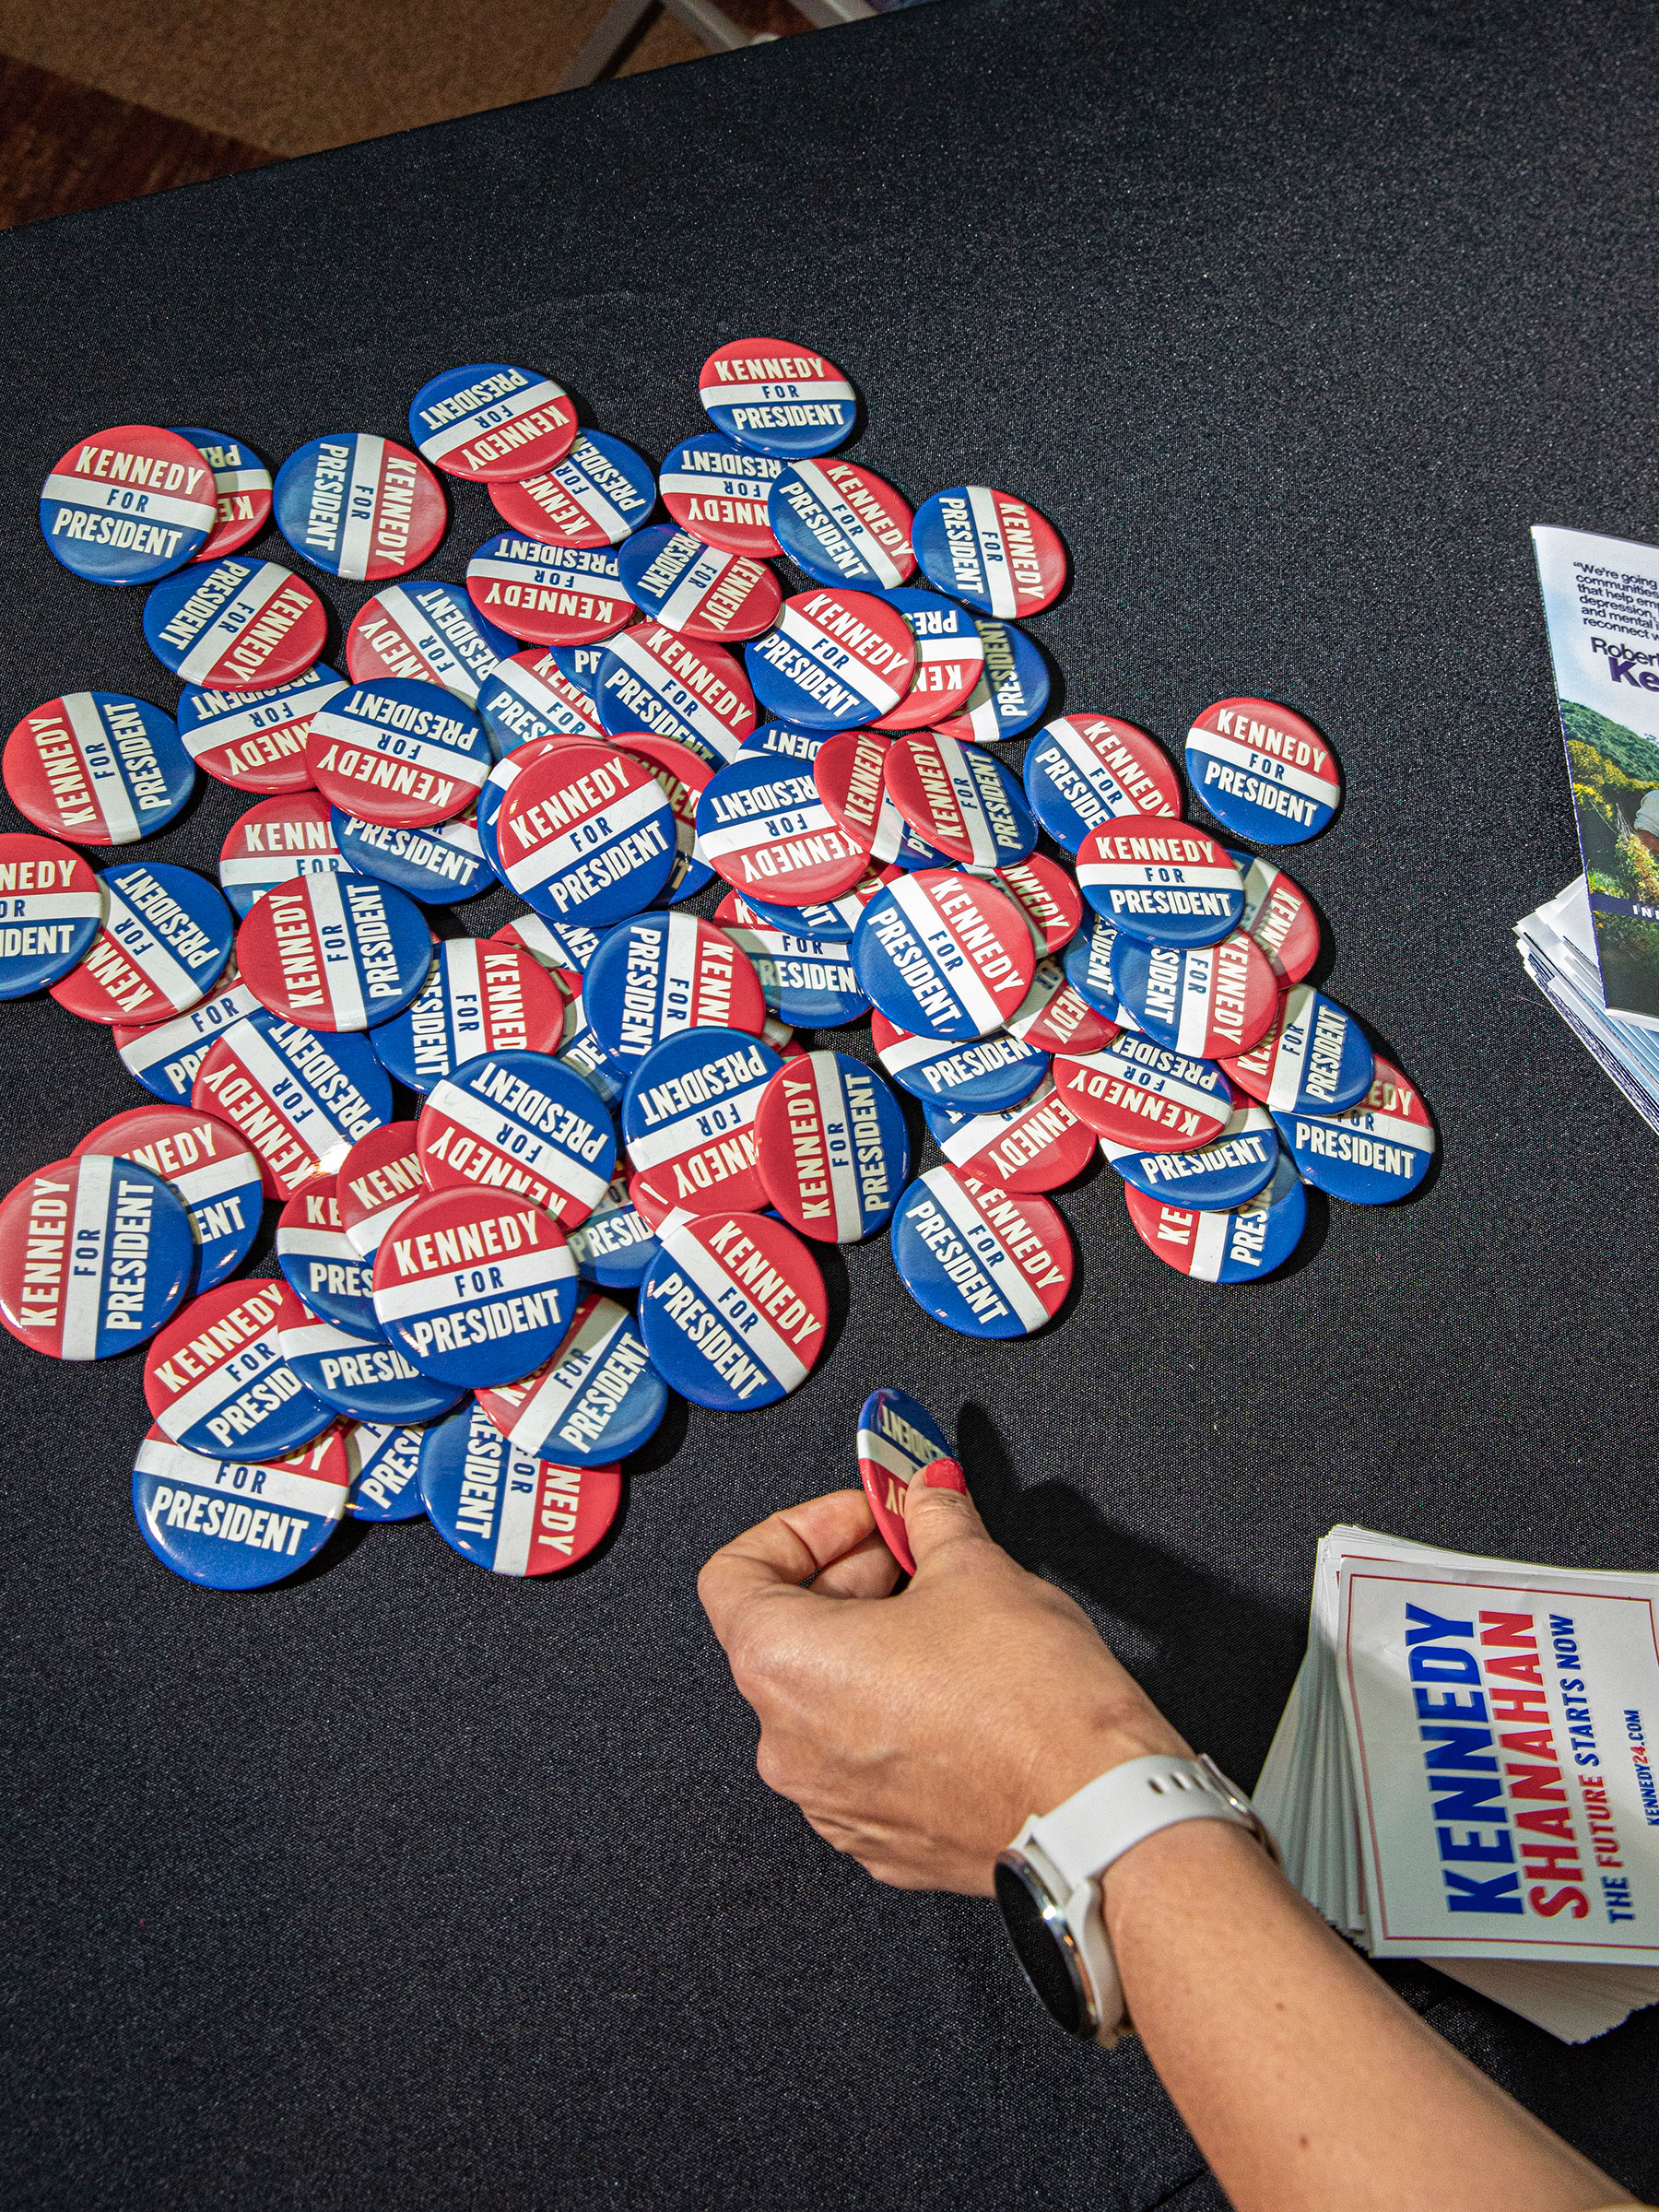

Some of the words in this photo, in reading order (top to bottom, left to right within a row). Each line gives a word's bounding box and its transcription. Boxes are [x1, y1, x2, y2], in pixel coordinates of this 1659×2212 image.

[714, 358, 826, 382] KENNEDY
[761, 384, 799, 399] FOR
[419, 369, 529, 430] PRESIDENT
[475, 405, 512, 429] FOR
[733, 404, 845, 430] PRESIDENT
[461, 406, 570, 471] KENNEDY
[681, 450, 783, 478] RESIDENT
[76, 446, 206, 494] KENNEDY
[305, 443, 349, 551] PRESIDENT
[551, 465, 589, 495] FOR
[724, 481, 761, 499] FOR
[107, 488, 148, 512] FOR
[355, 486, 373, 520] FOR
[375, 457, 417, 565] KENNEDY
[827, 465, 915, 558] KENNEDY
[832, 503, 864, 537] FOR
[53, 508, 182, 559] PRESIDENT
[495, 539, 618, 579] PRESIDENT
[779, 481, 869, 579] PRESIDENT
[938, 497, 983, 594] PRESIDENT
[982, 531, 1004, 562] FOR
[999, 502, 1044, 599] KENNEDY
[535, 571, 575, 588] FOR
[637, 533, 702, 598] RESIDENT
[688, 562, 718, 589] FOR
[700, 556, 767, 631] KENNEDY
[1577, 583, 1604, 597] that
[1606, 589, 1633, 605] help
[1621, 573, 1658, 591] going
[159, 559, 251, 650] PRESIDENT
[218, 601, 255, 633] FOR
[485, 582, 614, 624] KENNEDY
[1579, 594, 1656, 622] depression,
[1582, 606, 1606, 618] and
[1609, 611, 1653, 629] mental
[1583, 618, 1649, 640] reconnect
[223, 589, 313, 682] KENNEDY
[418, 633, 455, 673] FOR
[802, 593, 910, 676] KENNEDY
[811, 638, 849, 669] FOR
[646, 626, 753, 728] KENNEDY
[661, 679, 699, 717] FOR
[753, 634, 862, 717] PRESIDENT
[248, 701, 295, 728] FOR
[343, 690, 479, 752] PRESIDENT
[546, 704, 586, 735] FOR
[604, 668, 717, 763] PRESIDENT
[1216, 709, 1326, 774] KENNEDY
[28, 715, 97, 826] KENNEDY
[86, 742, 115, 781] FOR
[103, 702, 171, 810] PRESIDENT
[377, 733, 422, 760] FOR
[1084, 720, 1175, 818] KENNEDY
[1249, 753, 1285, 781] FOR
[317, 745, 454, 808] KENNEDY
[509, 757, 630, 849] KENNEDY
[711, 774, 820, 822] RESIDENT
[844, 735, 887, 826] KENNEDY
[908, 740, 965, 838] KENNEDY
[953, 777, 978, 809] FOR
[966, 750, 1022, 850] PRESIDENT
[1035, 747, 1111, 830] PRESIDE
[1088, 768, 1122, 805] FOR
[1204, 762, 1319, 827] PRESIDENT
[244, 821, 339, 852] KENN
[345, 817, 479, 886] PRESIDENT
[570, 817, 613, 853] FOR
[766, 813, 807, 837] FOR
[1095, 837, 1214, 864] KENNEDY
[547, 819, 668, 914] PRESIDENT
[740, 830, 863, 883] KENNEDY
[1145, 867, 1185, 883] FOR
[113, 868, 220, 969] PRESIDENT
[1111, 889, 1231, 916] PRESIDENT
[1259, 888, 1301, 955] KENN
[114, 917, 154, 956] FOR
[270, 893, 324, 1008] KENNEDY
[322, 924, 348, 962] FOR
[347, 885, 402, 999] PRESIDENT
[782, 935, 823, 955] FOR
[927, 930, 964, 972] FOR
[929, 877, 1024, 994] KENNEDY
[87, 935, 154, 1013] KENN
[619, 926, 662, 1057] PRESIDENT
[697, 941, 733, 1027] KENN
[866, 907, 962, 1027] PRESIDENT
[1145, 947, 1180, 1024] SIDENT
[1188, 957, 1209, 994] FOR
[1213, 936, 1249, 1045] KENNEDY
[192, 997, 240, 1032] FOR
[455, 994, 480, 1032] FOR
[484, 953, 527, 1050] KENNED
[666, 977, 689, 1020] FOR
[922, 1036, 1042, 1094] PRESIDEN
[1112, 1036, 1218, 1091] PRESIDEN
[1281, 1022, 1304, 1057] FOR
[1305, 1004, 1348, 1103] PRESIDENT
[267, 1023, 382, 1142] PRESIDENT
[273, 1077, 314, 1124] FOR
[638, 1043, 768, 1125] PRESIDENT
[1066, 1068, 1200, 1137] KENNEDY
[1124, 1065, 1166, 1092] FOR
[204, 1063, 314, 1190] KENNEDY
[469, 1062, 607, 1163] PRESIDENT
[696, 1102, 742, 1136] FOR
[988, 1098, 1077, 1180] ENNEDY
[496, 1122, 544, 1164] FOR
[782, 1078, 830, 1220] KENNEDY
[829, 1122, 849, 1167] FOR
[844, 1073, 891, 1212] PRESIDENT
[1139, 1135, 1268, 1185] PRESIDENT
[1295, 1122, 1417, 1180] PRESIDENT
[20, 1178, 70, 1326] KENNEDY
[74, 1229, 101, 1277] FOR
[106, 1181, 154, 1329] PRESIDENT
[392, 1209, 539, 1277] KENNEDY
[964, 1175, 1065, 1289] KENNEDY
[967, 1224, 1006, 1267] FOR
[453, 1265, 505, 1298] FOR
[708, 1219, 822, 1346] KENNEDY
[906, 1200, 1008, 1324] PRESIDENT
[153, 1282, 286, 1394] KENNEDY
[412, 1288, 562, 1358] PRESIDENT
[652, 1271, 769, 1401] PRESIDENT
[717, 1286, 759, 1335] FOR
[225, 1341, 276, 1382] FOR
[321, 1350, 420, 1390] PRESID
[553, 1347, 592, 1389] FOR
[206, 1366, 303, 1448] PRESID
[559, 1332, 650, 1454] PRESIDENT
[215, 1462, 267, 1495] FOR
[150, 1486, 310, 1556] PRESIDENT
[1549, 1615, 1581, 1670] NOW
[1559, 1677, 1600, 1767] STARTS
[1406, 1601, 1524, 1915] KENNEDY
[1479, 1610, 1590, 1919] SHANAHAN
[1624, 1710, 1659, 1827] KENNEDY24.COM
[1578, 1774, 1620, 1868] FUTURE
[1602, 1876, 1636, 1924] THE
